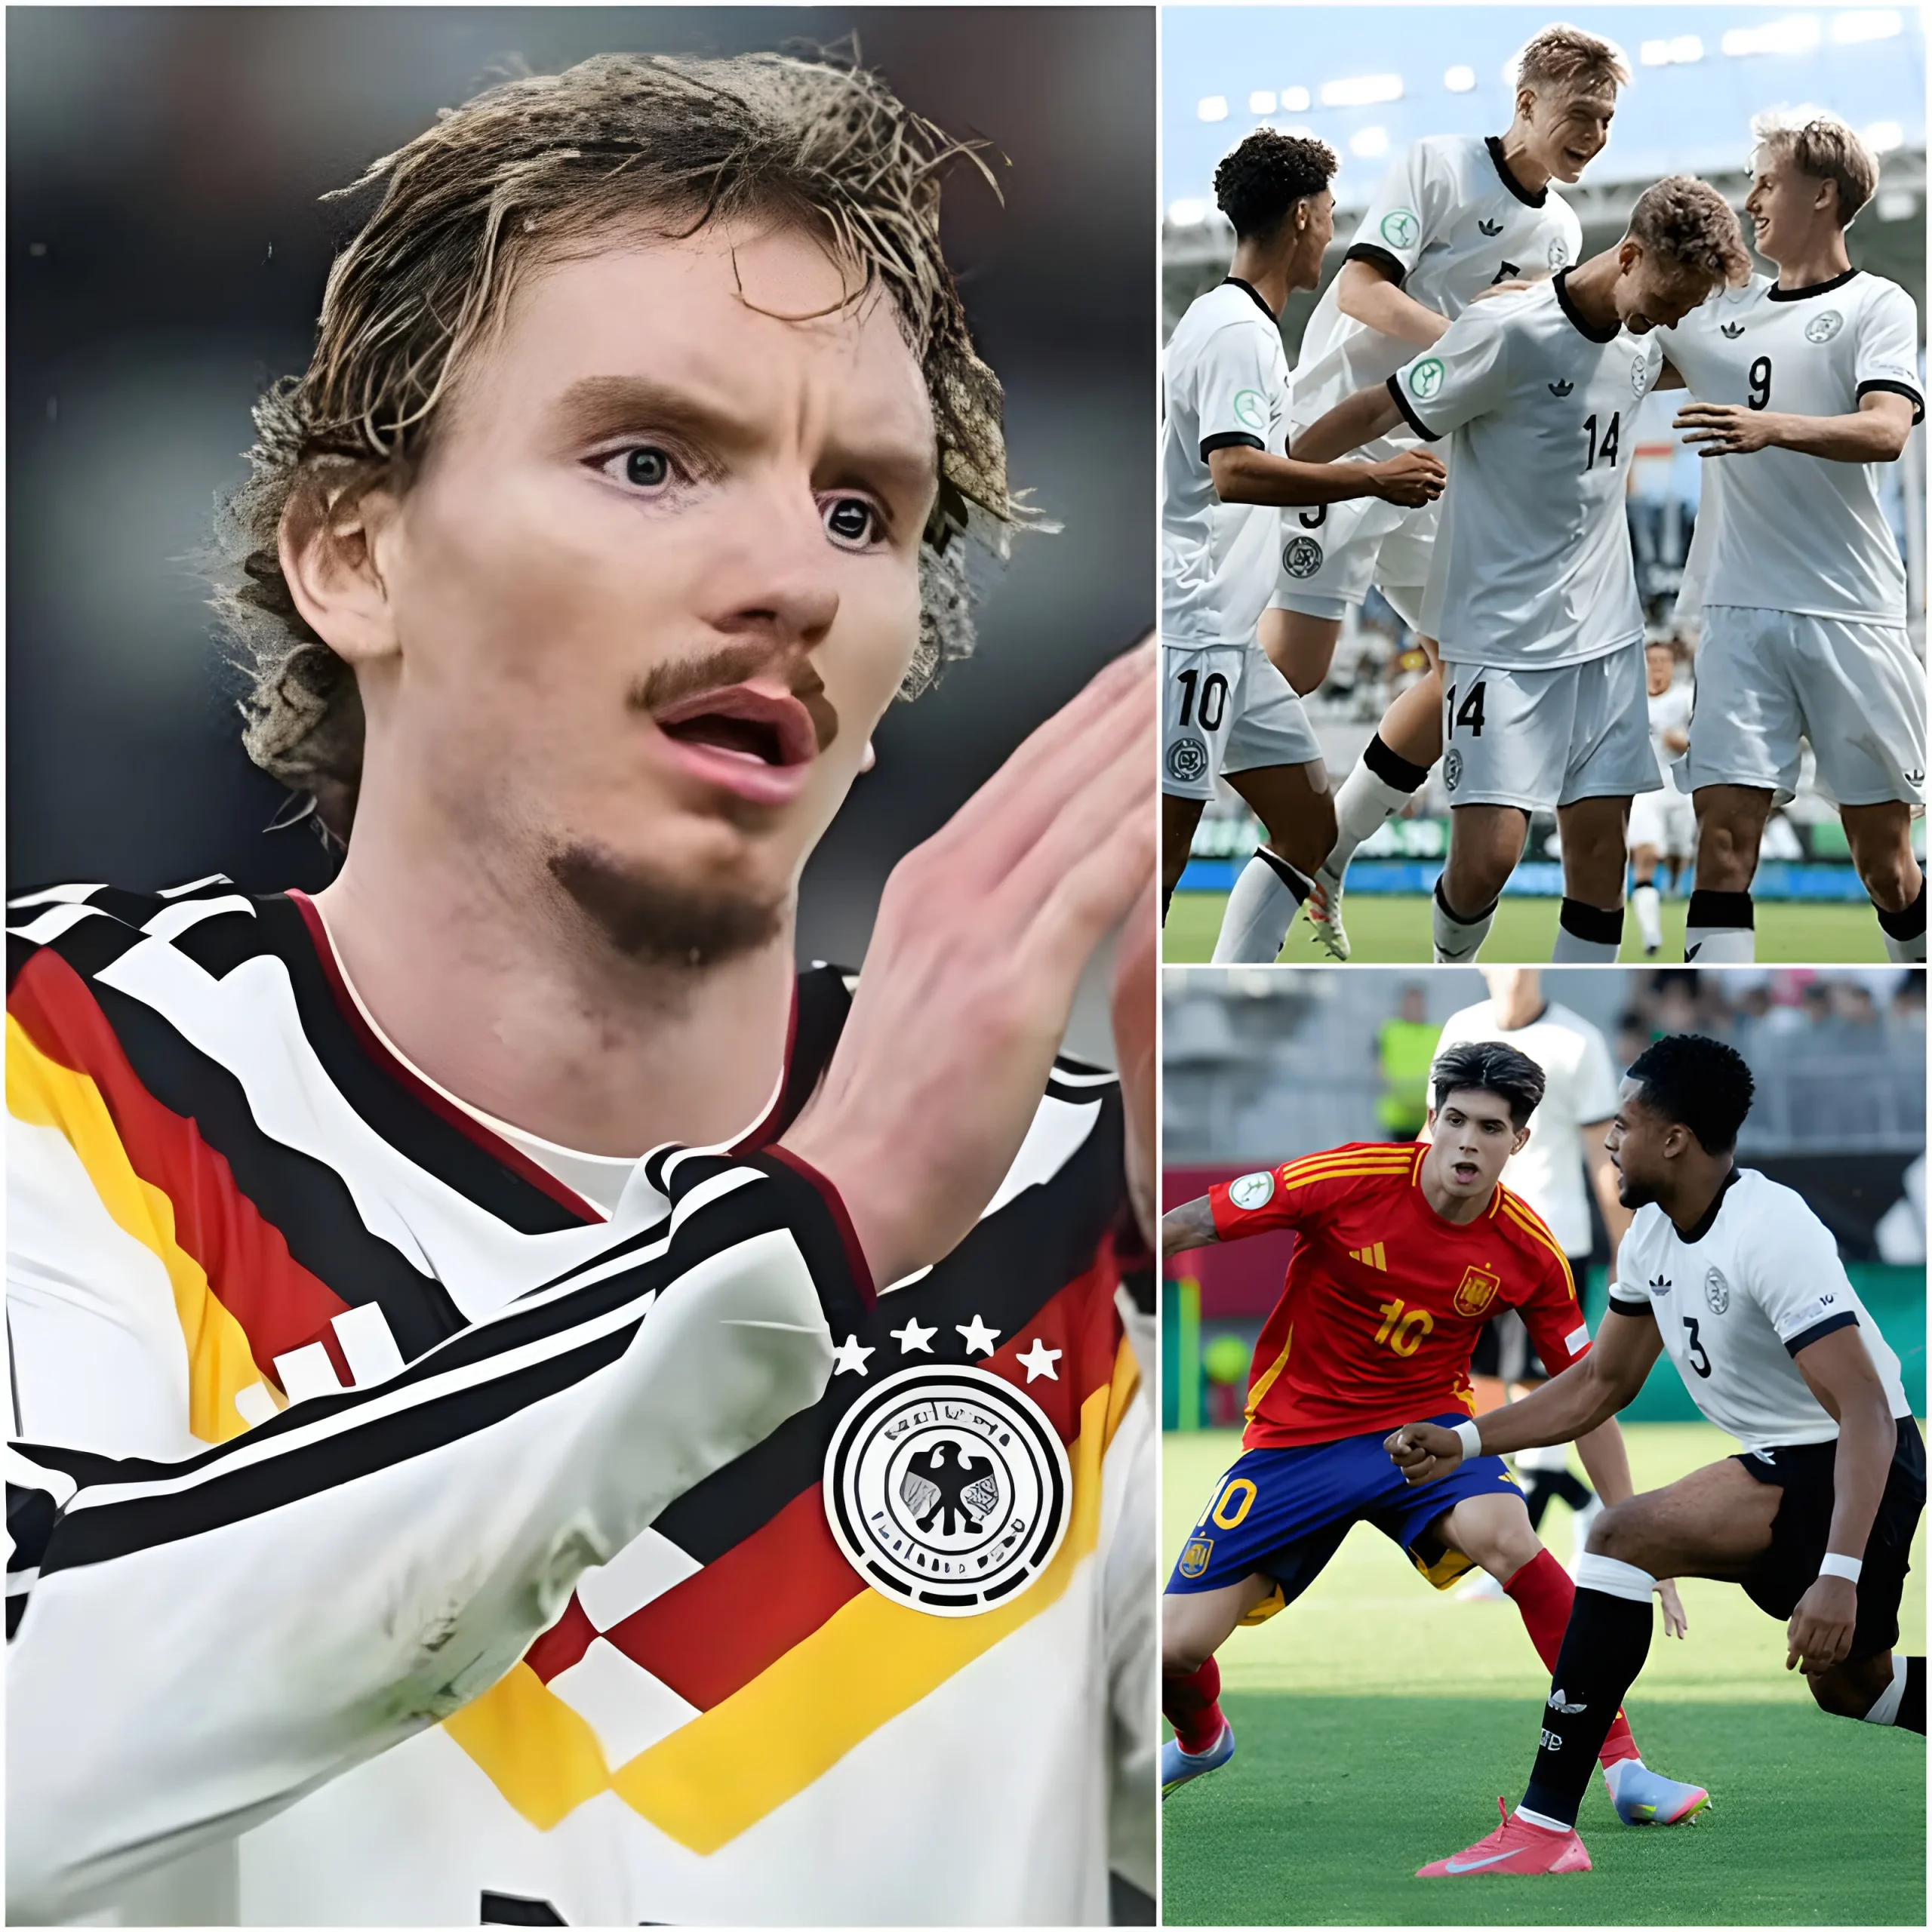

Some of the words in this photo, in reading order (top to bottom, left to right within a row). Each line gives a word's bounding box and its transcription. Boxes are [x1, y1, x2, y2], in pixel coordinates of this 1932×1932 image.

[1748, 355, 1772, 411] 9
[1582, 411, 1620, 472] 14
[1177, 669, 1229, 731] 10
[1446, 681, 1487, 740] 14
[1374, 1298, 1434, 1357] 10
[1683, 1316, 1712, 1379] 3
